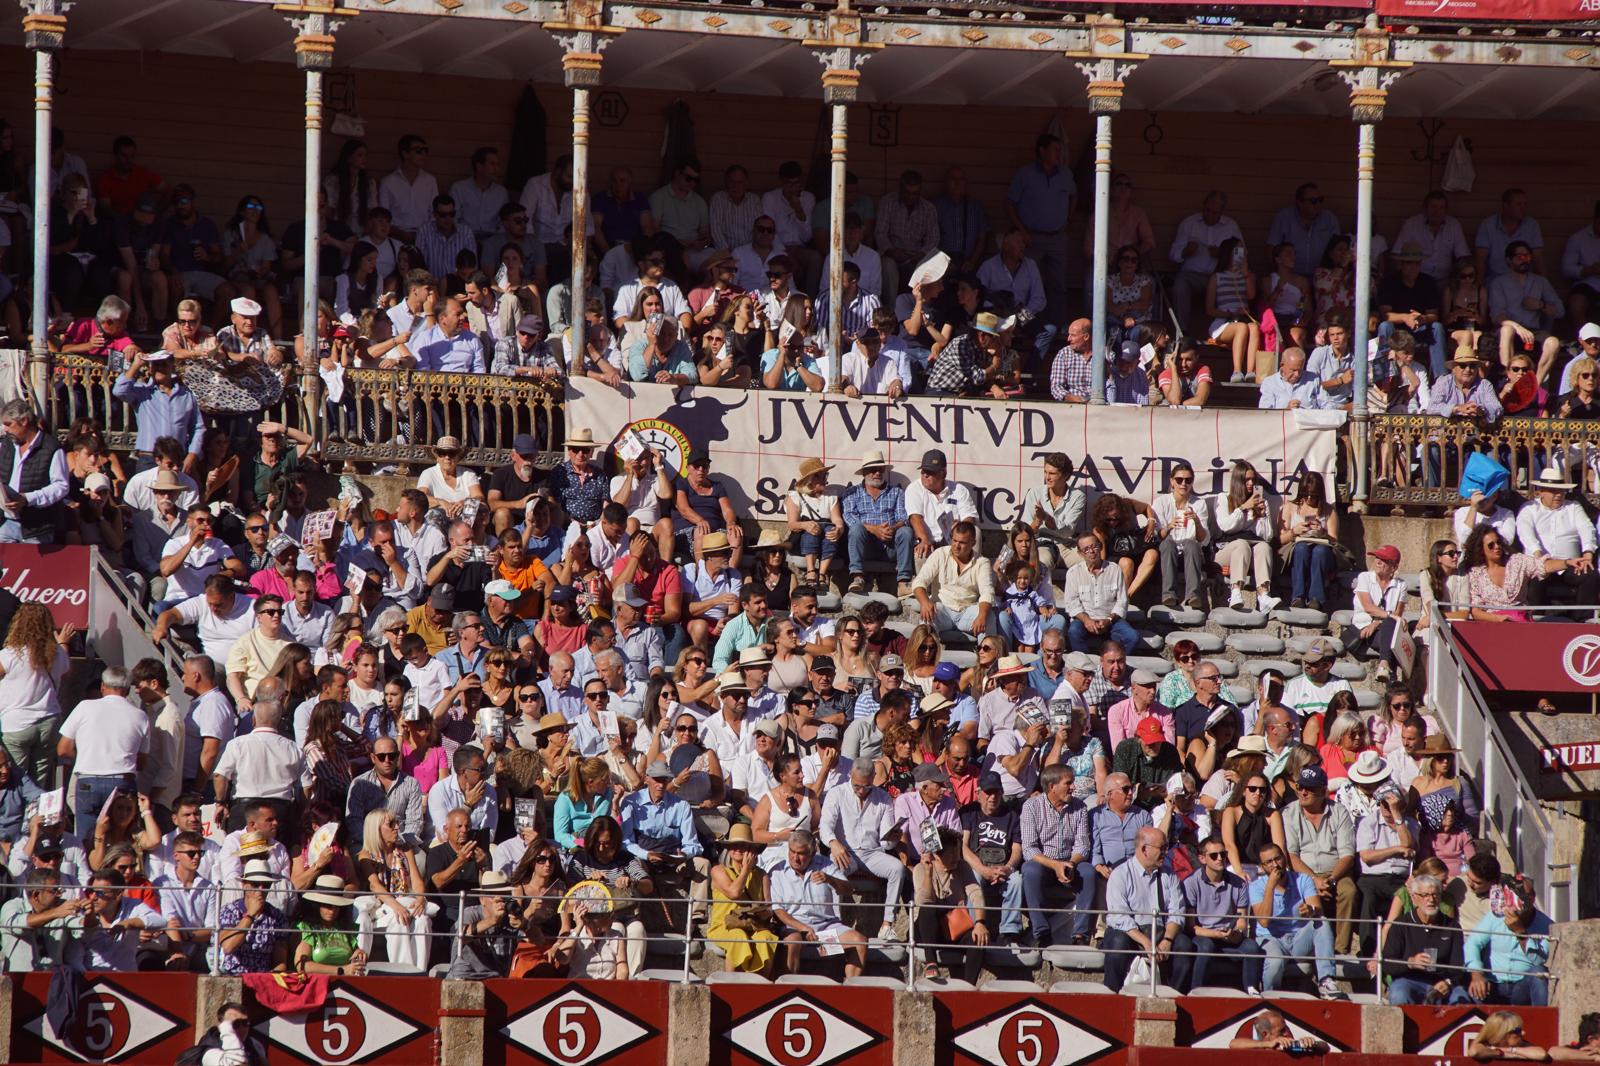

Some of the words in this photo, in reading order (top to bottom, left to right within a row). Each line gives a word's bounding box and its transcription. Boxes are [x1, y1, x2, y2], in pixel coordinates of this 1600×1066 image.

[758, 397, 1055, 447] JVVENTVD
[85, 1002, 115, 1050] 5
[322, 1007, 350, 1056] 5
[558, 1006, 587, 1058] 5
[783, 1012, 813, 1058] 5
[1017, 1019, 1043, 1066] 5
